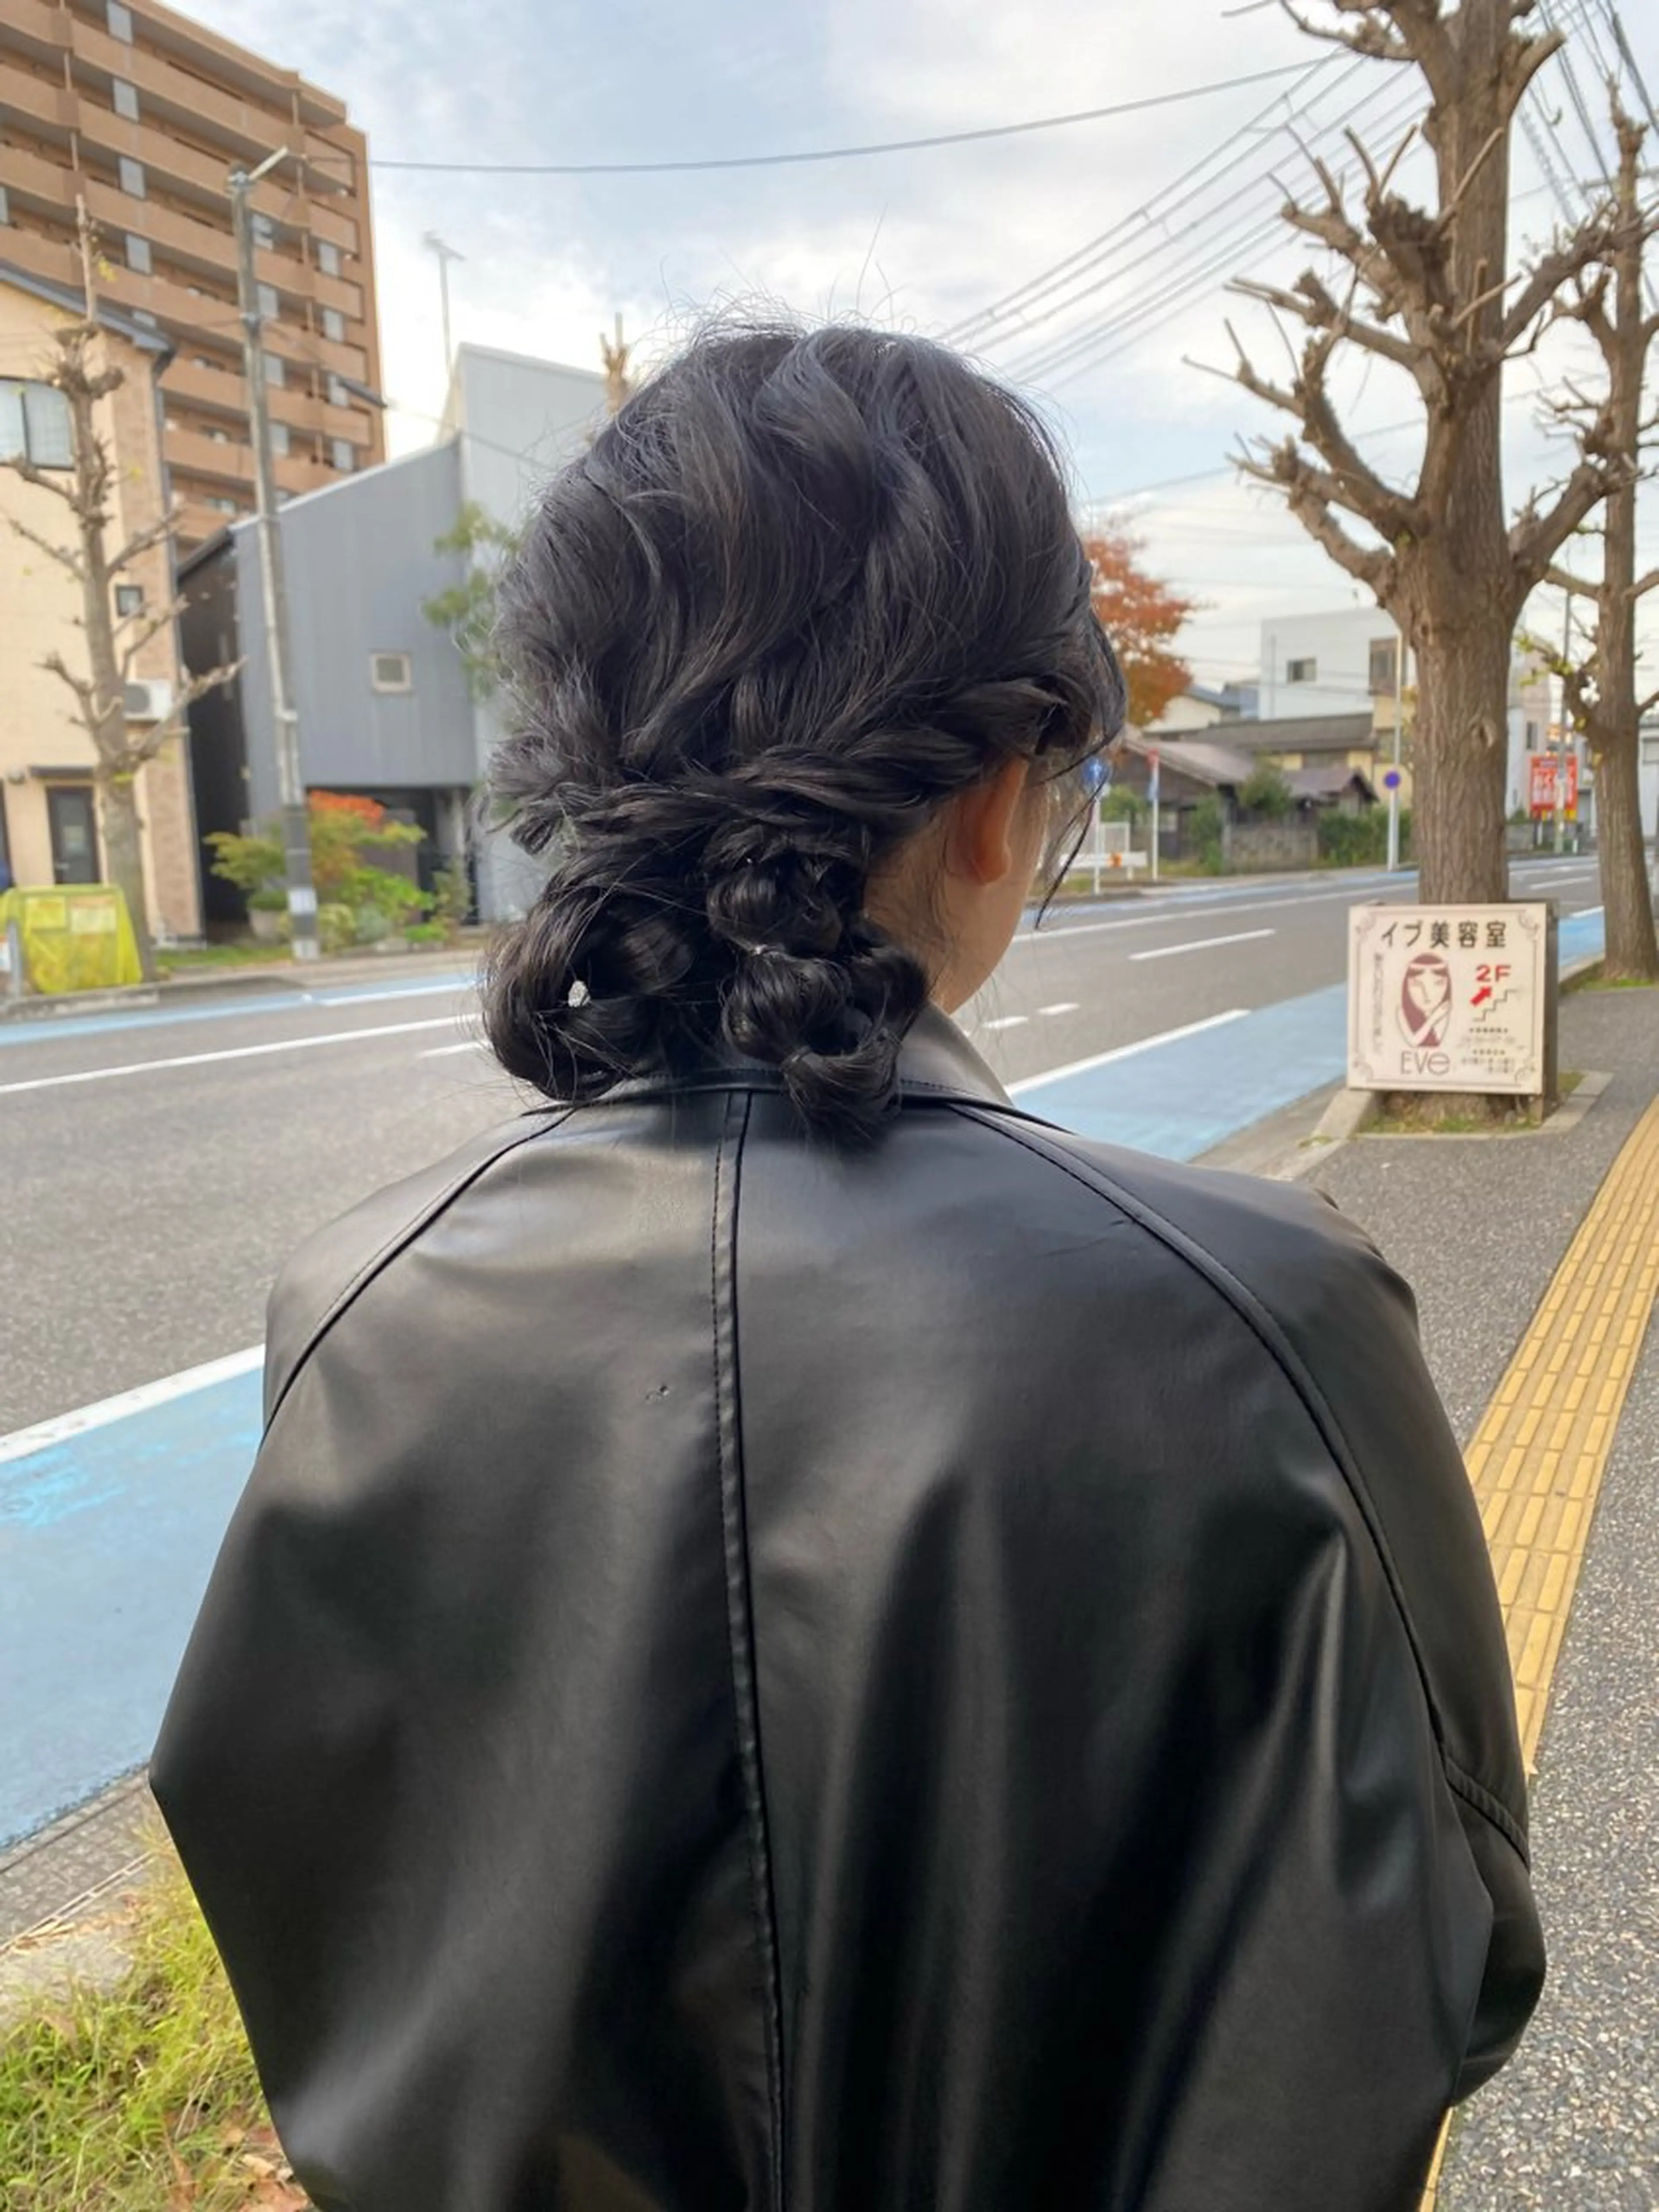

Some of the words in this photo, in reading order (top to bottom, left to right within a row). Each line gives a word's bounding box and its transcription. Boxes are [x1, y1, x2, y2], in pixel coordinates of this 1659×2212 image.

[1382, 920, 1506, 948] イブ美容室
[1476, 964, 1511, 982] 2F
